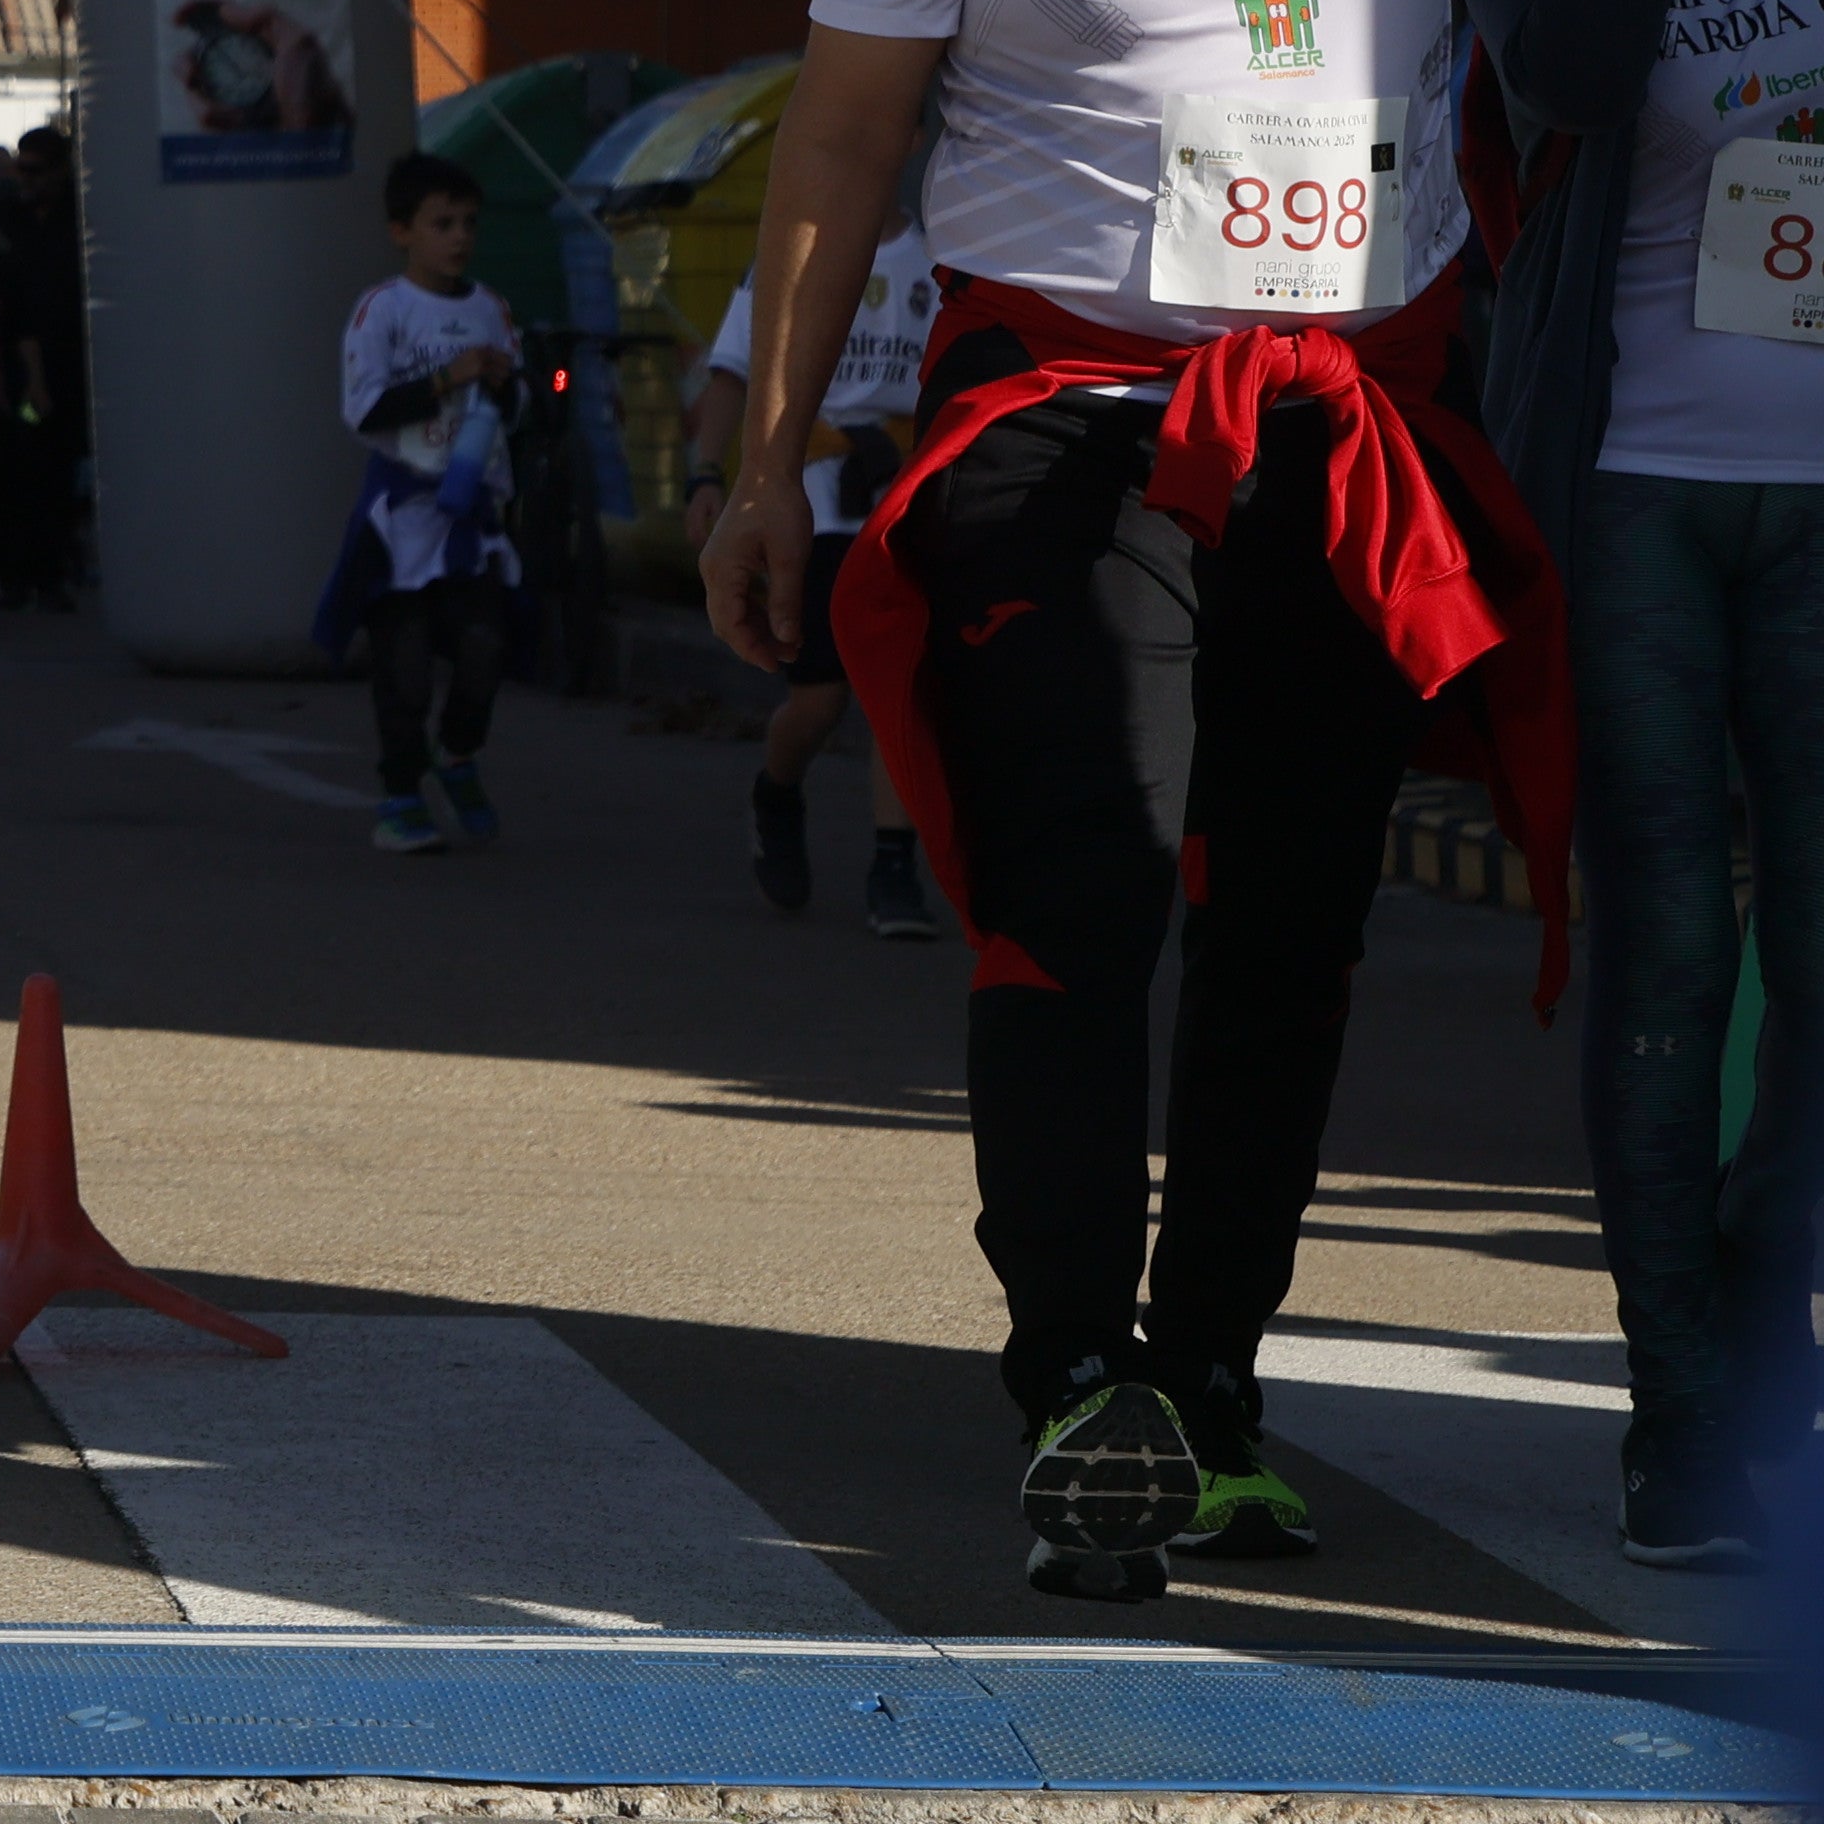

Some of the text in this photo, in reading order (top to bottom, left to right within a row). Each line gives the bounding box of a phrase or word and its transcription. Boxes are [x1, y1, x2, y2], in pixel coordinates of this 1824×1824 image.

[1247, 49, 1326, 71] ALCER
[1258, 69, 1316, 80] Salamanca
[1226, 111, 1294, 128] CARRERA
[1250, 132, 1331, 148] SALAMANCA
[1202, 149, 1244, 162] ALCER
[1750, 186, 1791, 201] ALCER
[1220, 176, 1368, 252] 898
[1254, 258, 1342, 279] nani grupo
[1254, 276, 1340, 289] EMPRESARIAL
